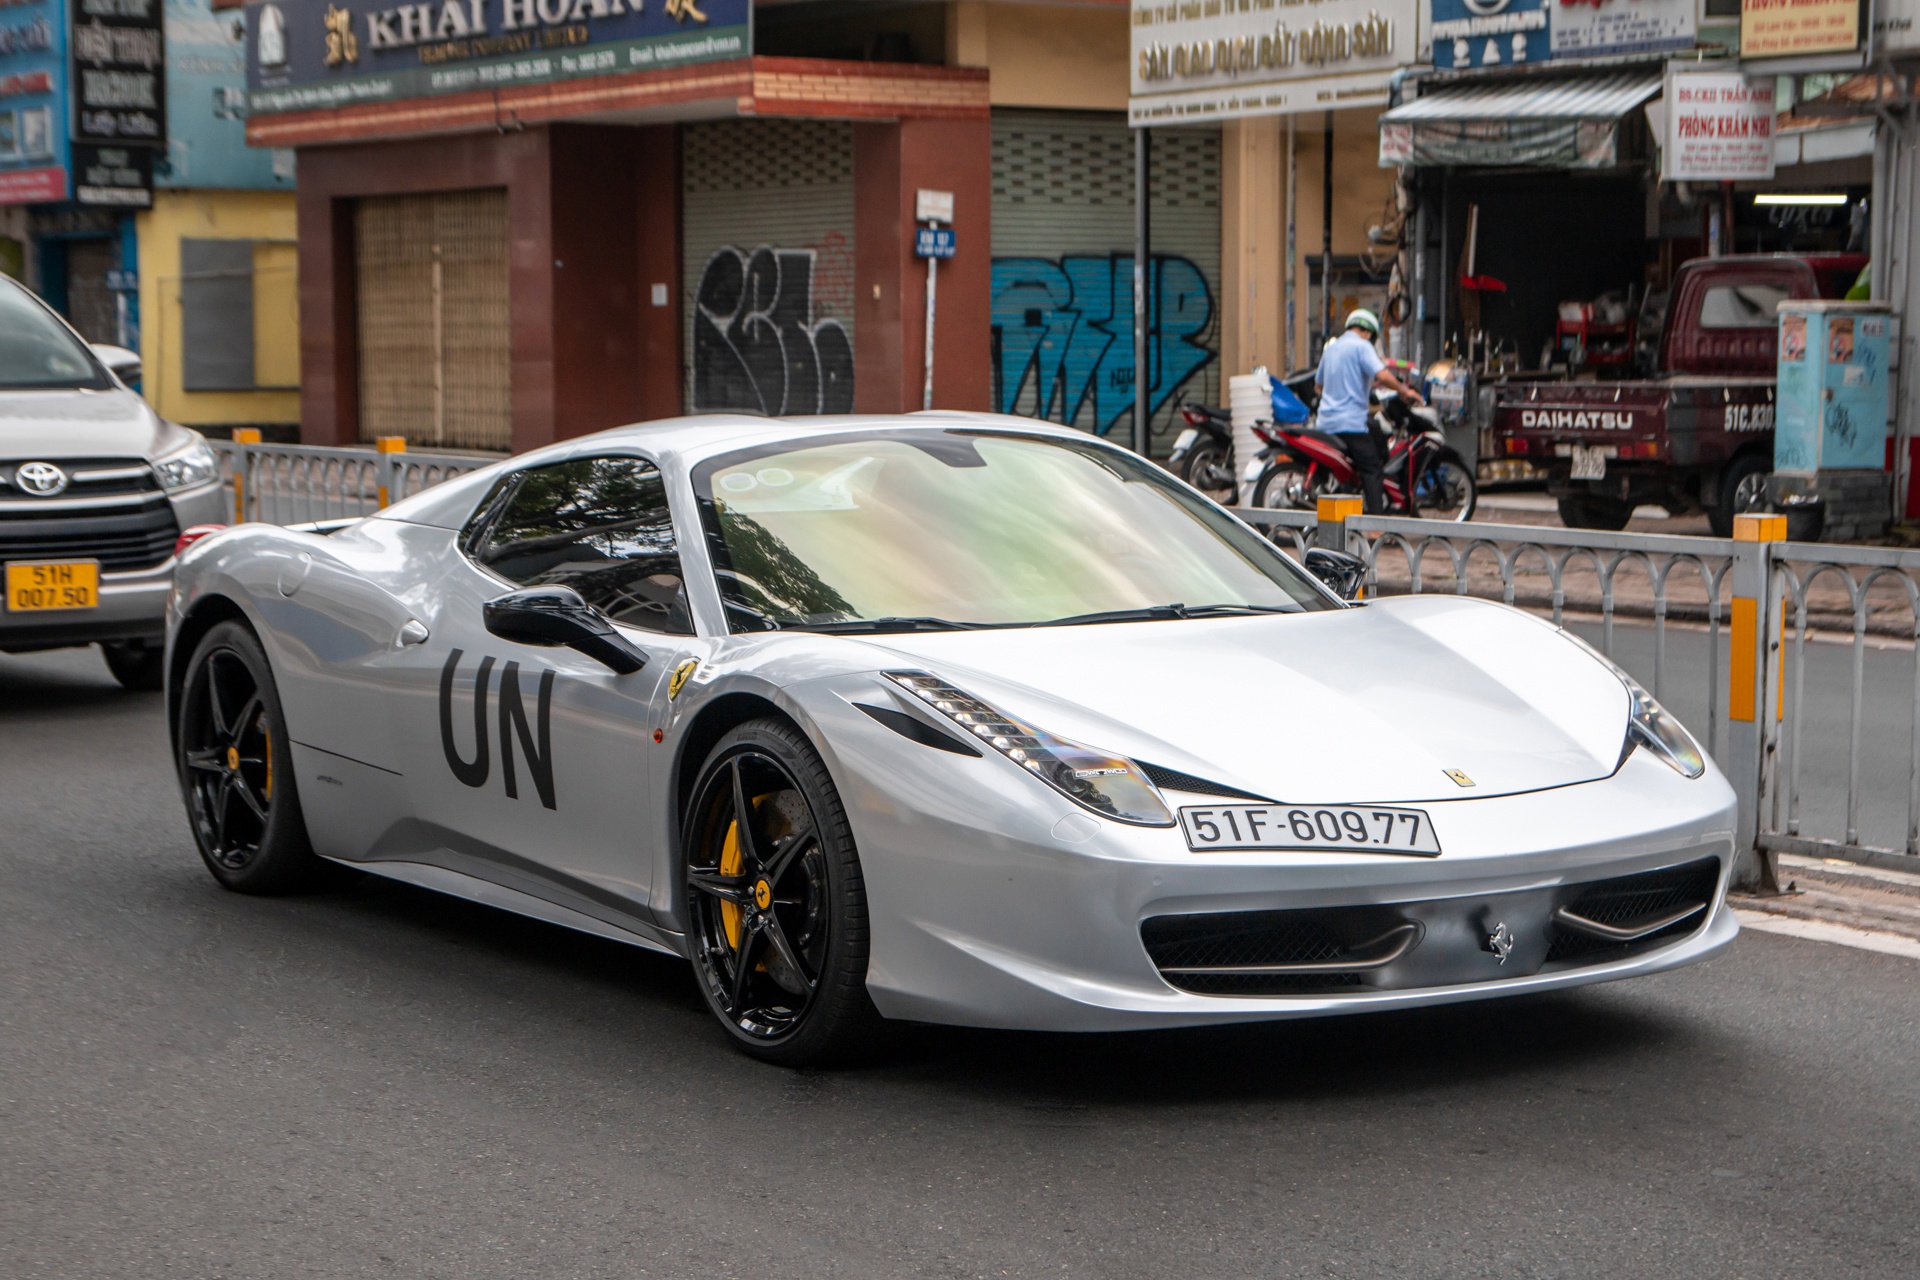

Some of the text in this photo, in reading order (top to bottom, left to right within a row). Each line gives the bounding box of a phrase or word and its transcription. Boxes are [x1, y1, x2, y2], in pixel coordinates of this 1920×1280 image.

[1678, 108, 1771, 139] PHÒNG KHÁM NHI
[1521, 410, 1634, 430] DAIHATSU
[33, 565, 73, 586] 51H
[17, 586, 89, 608] 007.50
[438, 647, 558, 811] UN
[1190, 809, 1421, 846] 51F-609.77
